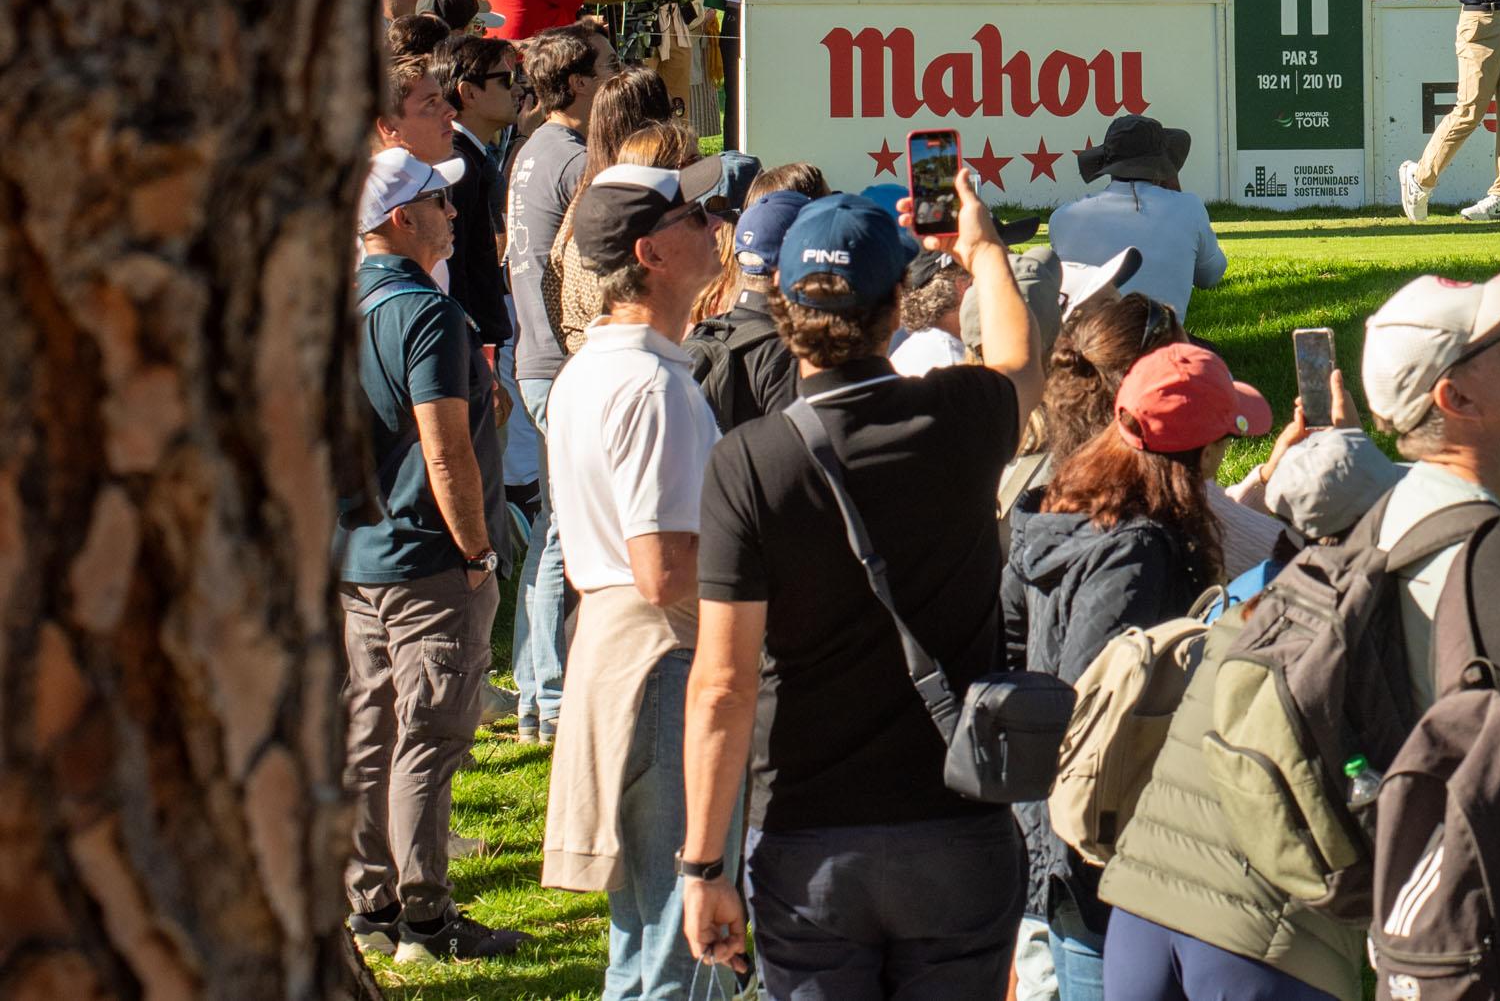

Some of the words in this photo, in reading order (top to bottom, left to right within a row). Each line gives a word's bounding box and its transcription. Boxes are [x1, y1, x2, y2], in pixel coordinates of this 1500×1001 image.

[1282, 51, 1307, 66] PAR
[1309, 51, 1318, 65] 3
[820, 24, 1151, 118] Mahou
[1257, 75, 1278, 89] 192
[1280, 75, 1290, 89] M
[1303, 74, 1323, 89] 210
[1326, 74, 1342, 89] YD
[1295, 117, 1330, 129] TOUR
[1294, 165, 1334, 175] CIUDADES
[1294, 177, 1300, 185] Y
[1301, 176, 1359, 186] COMUNIDADES
[1294, 187, 1349, 197] SOSTENIBLES
[802, 249, 850, 266] PING
